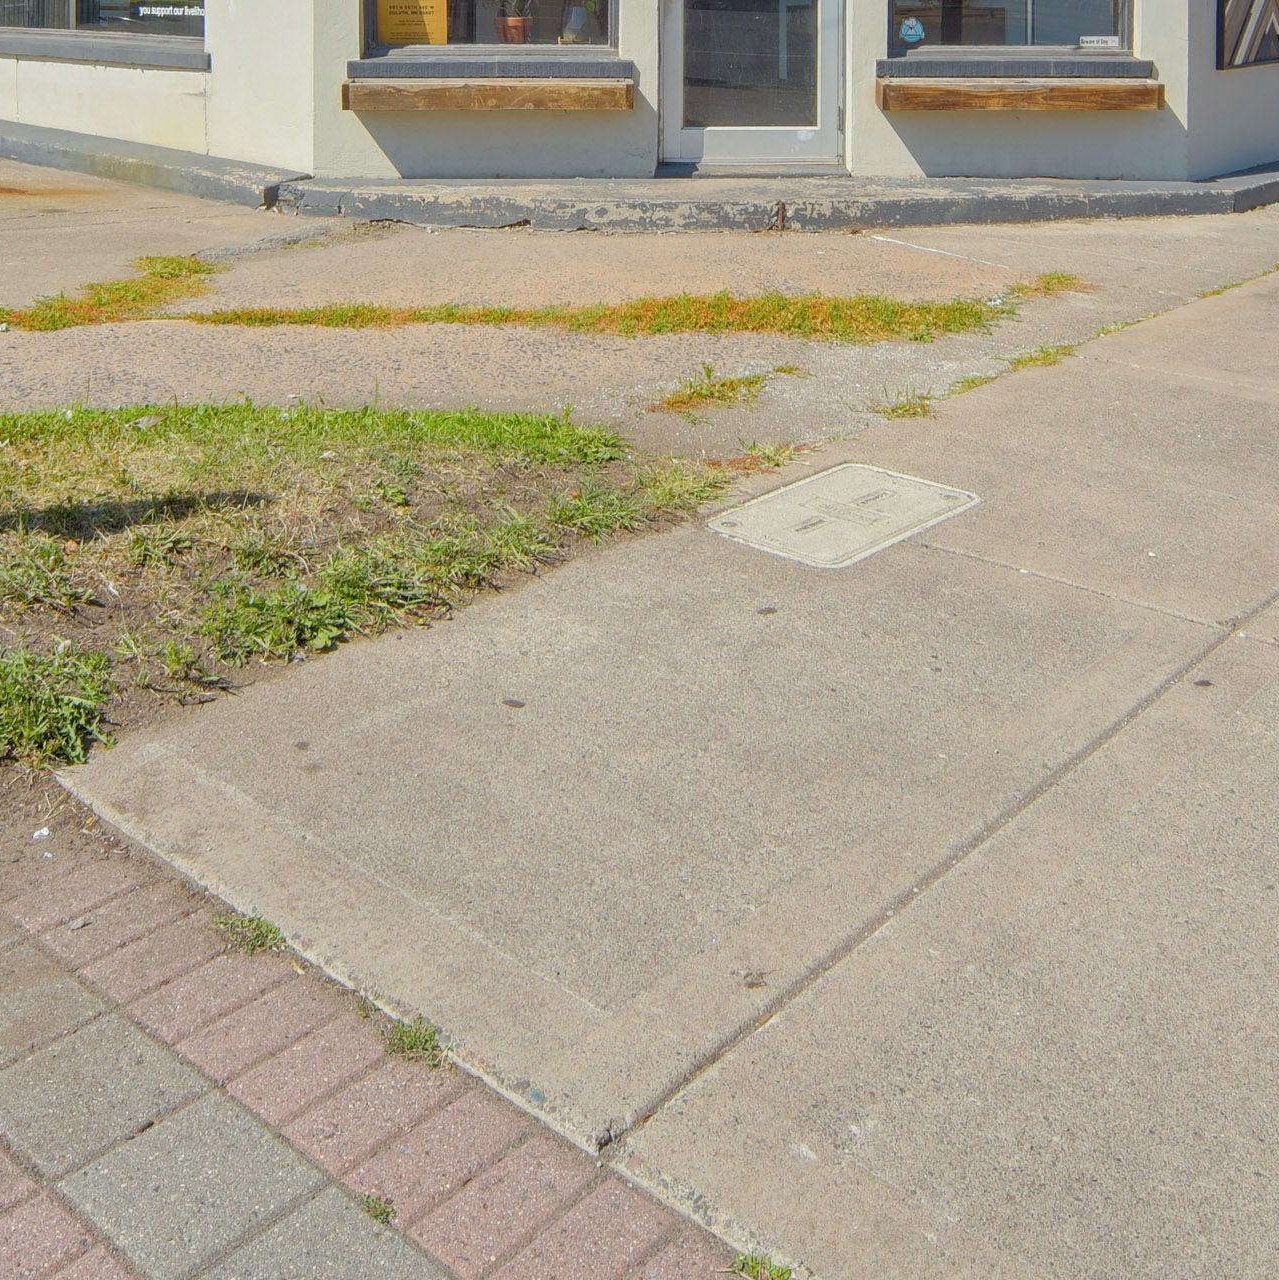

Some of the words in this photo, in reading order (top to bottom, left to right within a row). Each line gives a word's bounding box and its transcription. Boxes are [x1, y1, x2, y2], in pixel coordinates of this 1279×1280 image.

[139, 6, 150, 16] you
[151, 6, 173, 17] support
[173, 7, 184, 15] our
